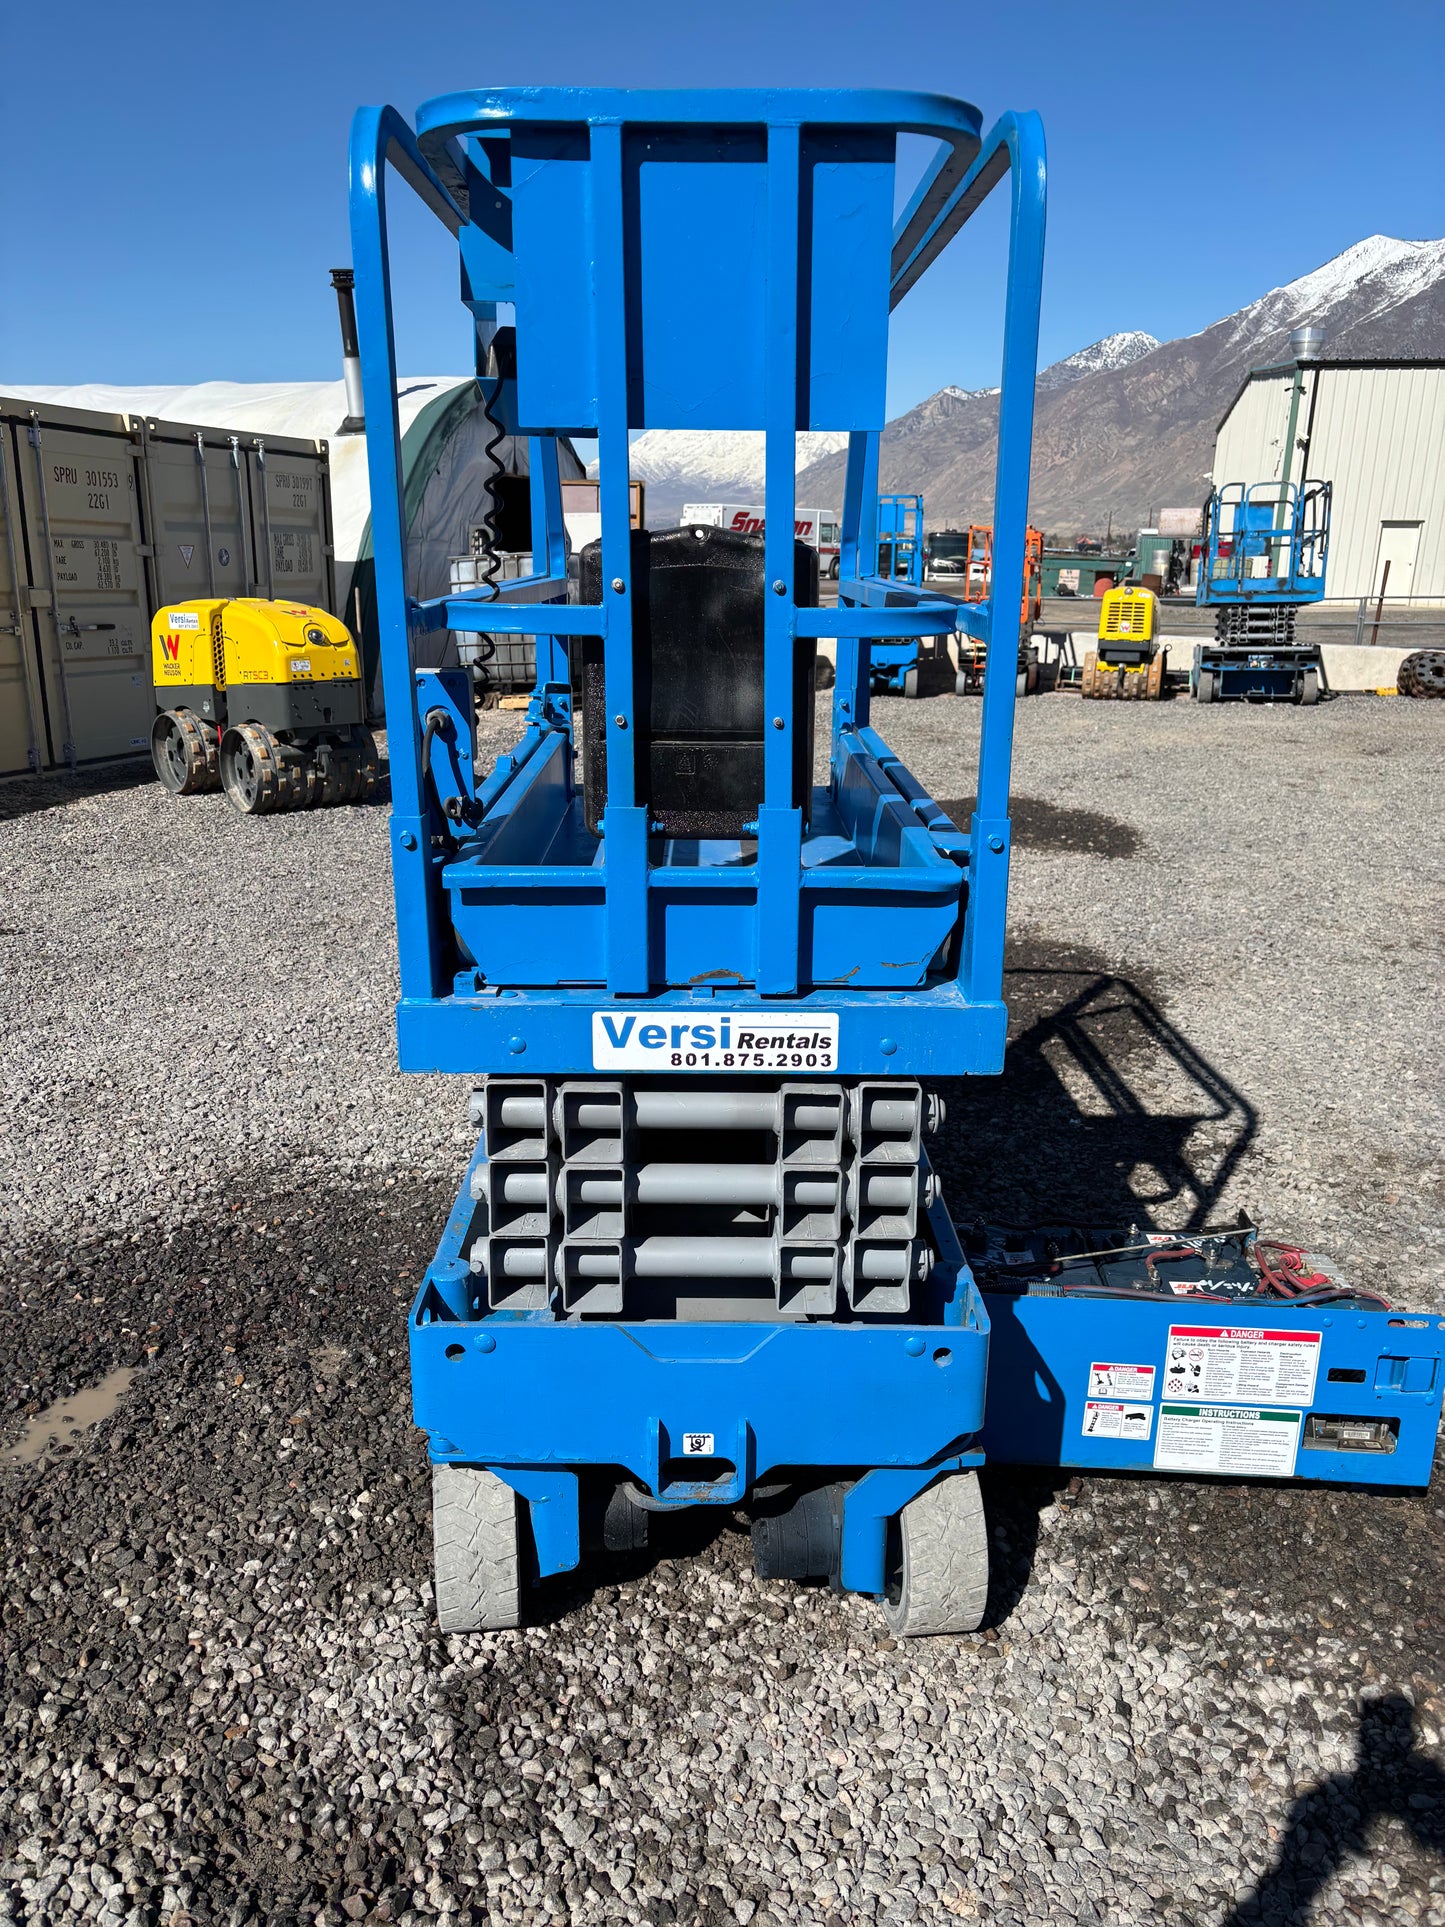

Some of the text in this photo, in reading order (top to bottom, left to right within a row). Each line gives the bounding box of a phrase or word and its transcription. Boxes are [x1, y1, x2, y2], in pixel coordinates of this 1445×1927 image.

[54, 466, 78, 484] SPRU
[86, 470, 118, 488] 301553
[276, 474, 290, 488] SPRU
[88, 493, 109, 510] 22G1
[293, 494, 307, 507] 22G1
[54, 540, 64, 548] MAX
[56, 556, 67, 564] TARE
[57, 572, 77, 581] PAYLOAD
[170, 614, 186, 623] Versi
[600, 1016, 832, 1049] Versi Rentals
[671, 1053, 832, 1067] 801.875.2903
[1230, 1330, 1264, 1339] DANGER
[1199, 1408, 1260, 1420] INSTRUCTIONS
